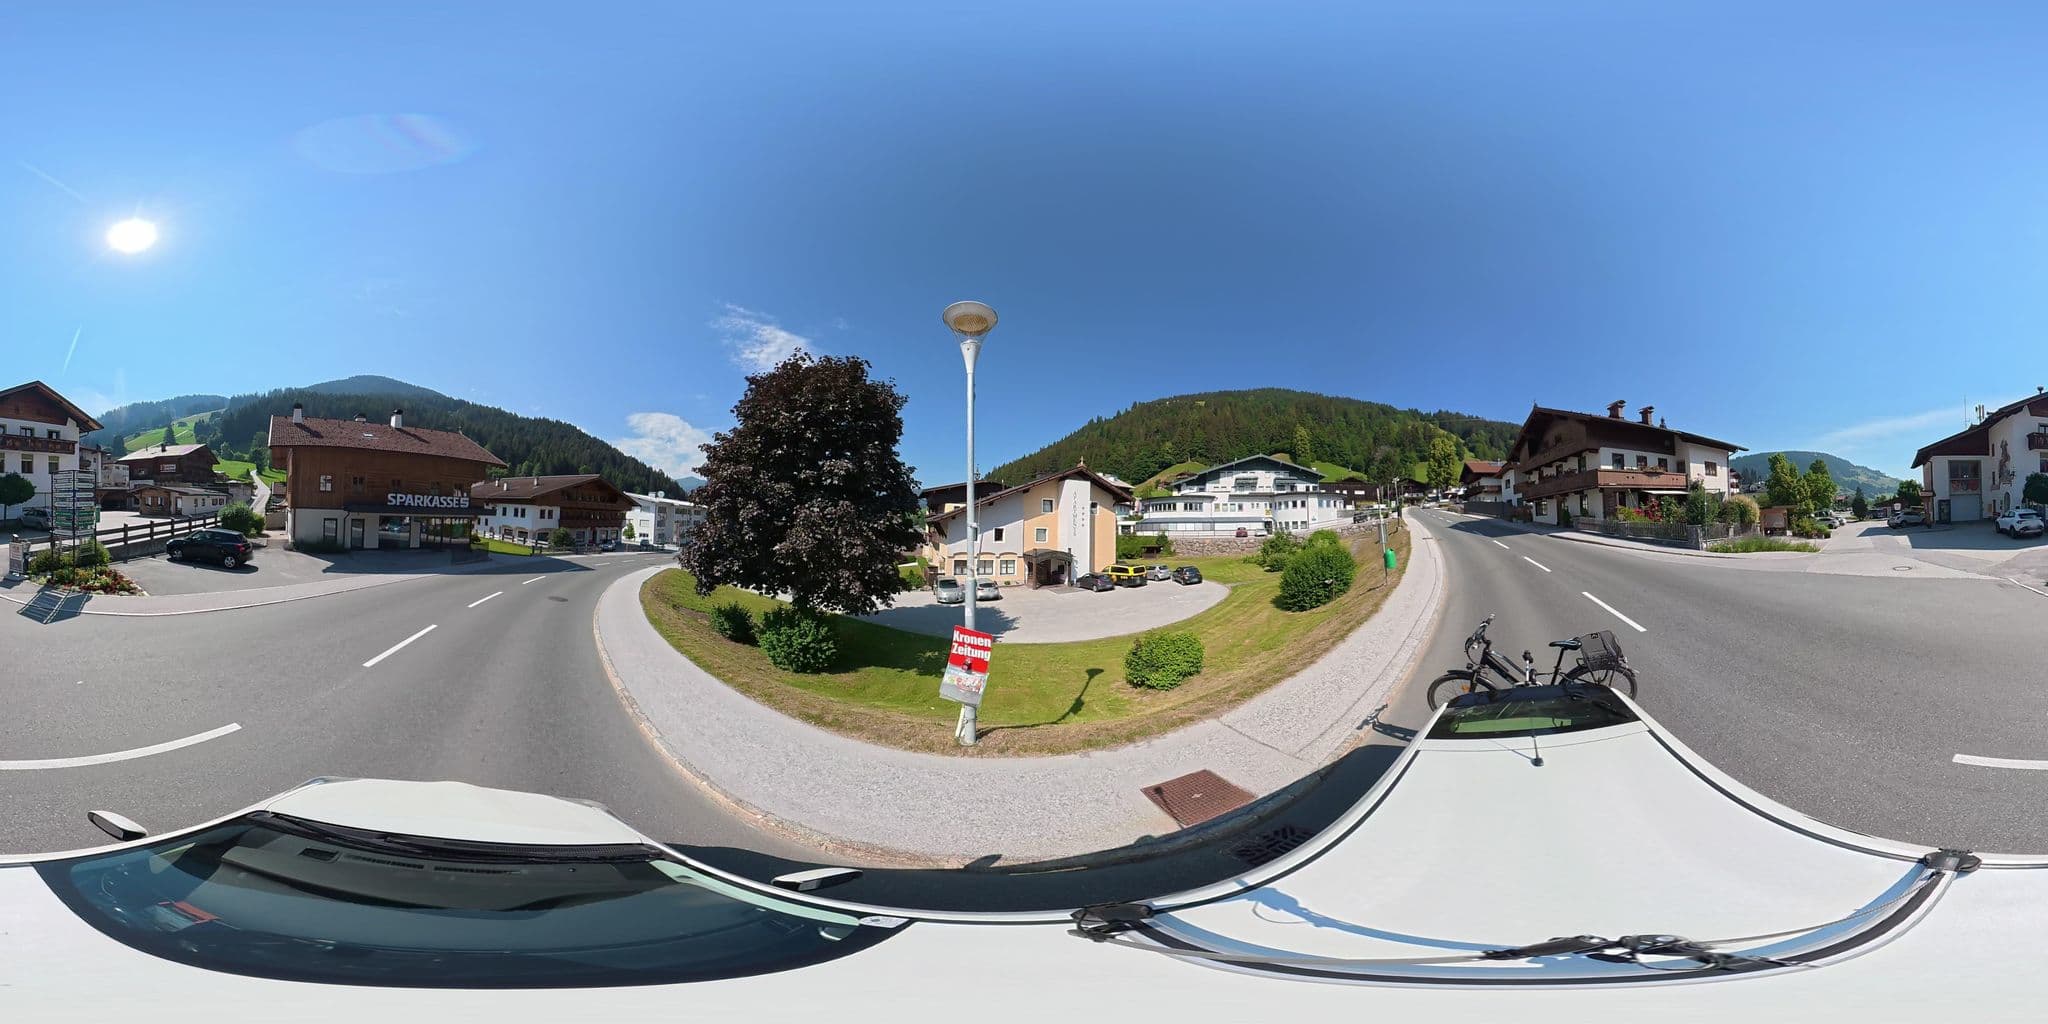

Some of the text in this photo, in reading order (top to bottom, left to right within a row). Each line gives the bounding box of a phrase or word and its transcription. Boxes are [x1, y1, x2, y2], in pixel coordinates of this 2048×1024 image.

[387, 493, 459, 508] SPARKASSE
[954, 630, 991, 648] Kronen
[952, 642, 991, 661] Zeitung
